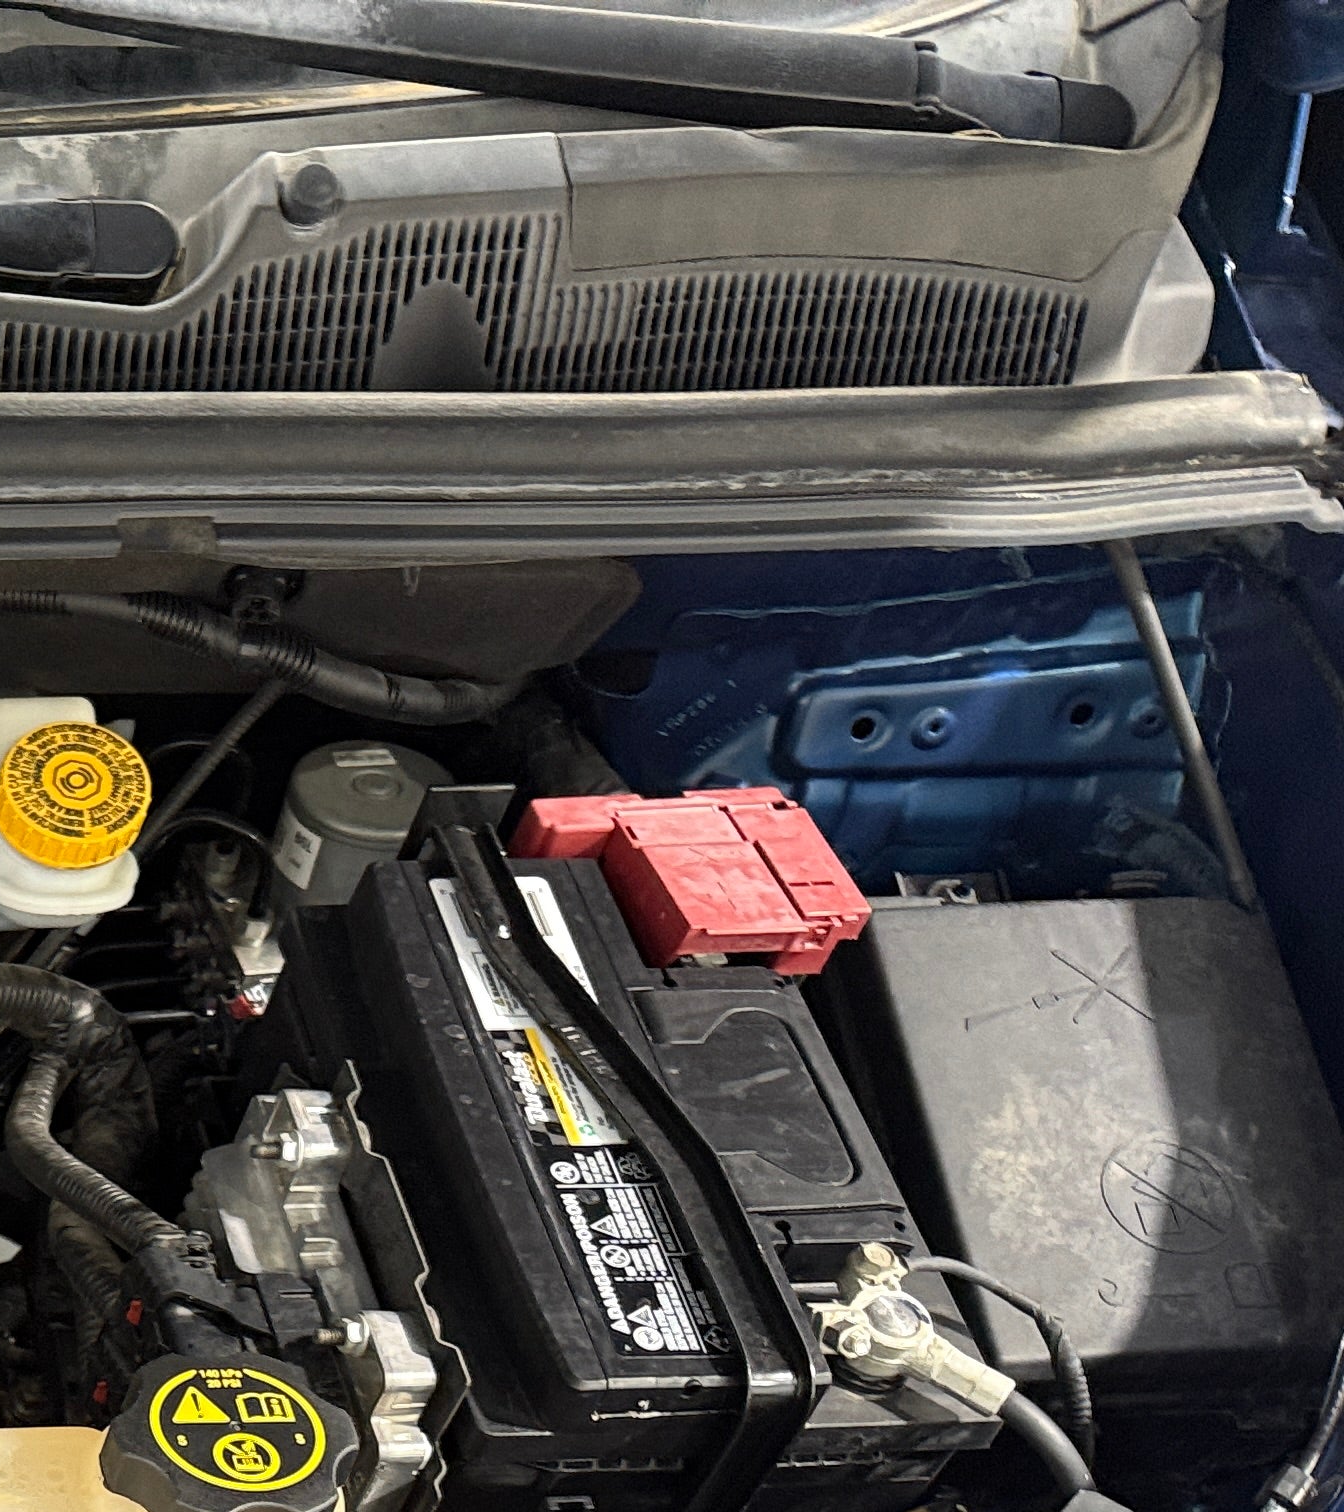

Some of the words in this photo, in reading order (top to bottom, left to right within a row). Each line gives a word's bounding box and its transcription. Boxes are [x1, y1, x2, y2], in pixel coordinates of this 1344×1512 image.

[502, 1051, 549, 1125] Duralast
[198, 1369, 220, 1378] 140
[206, 1379, 222, 1388] 20
